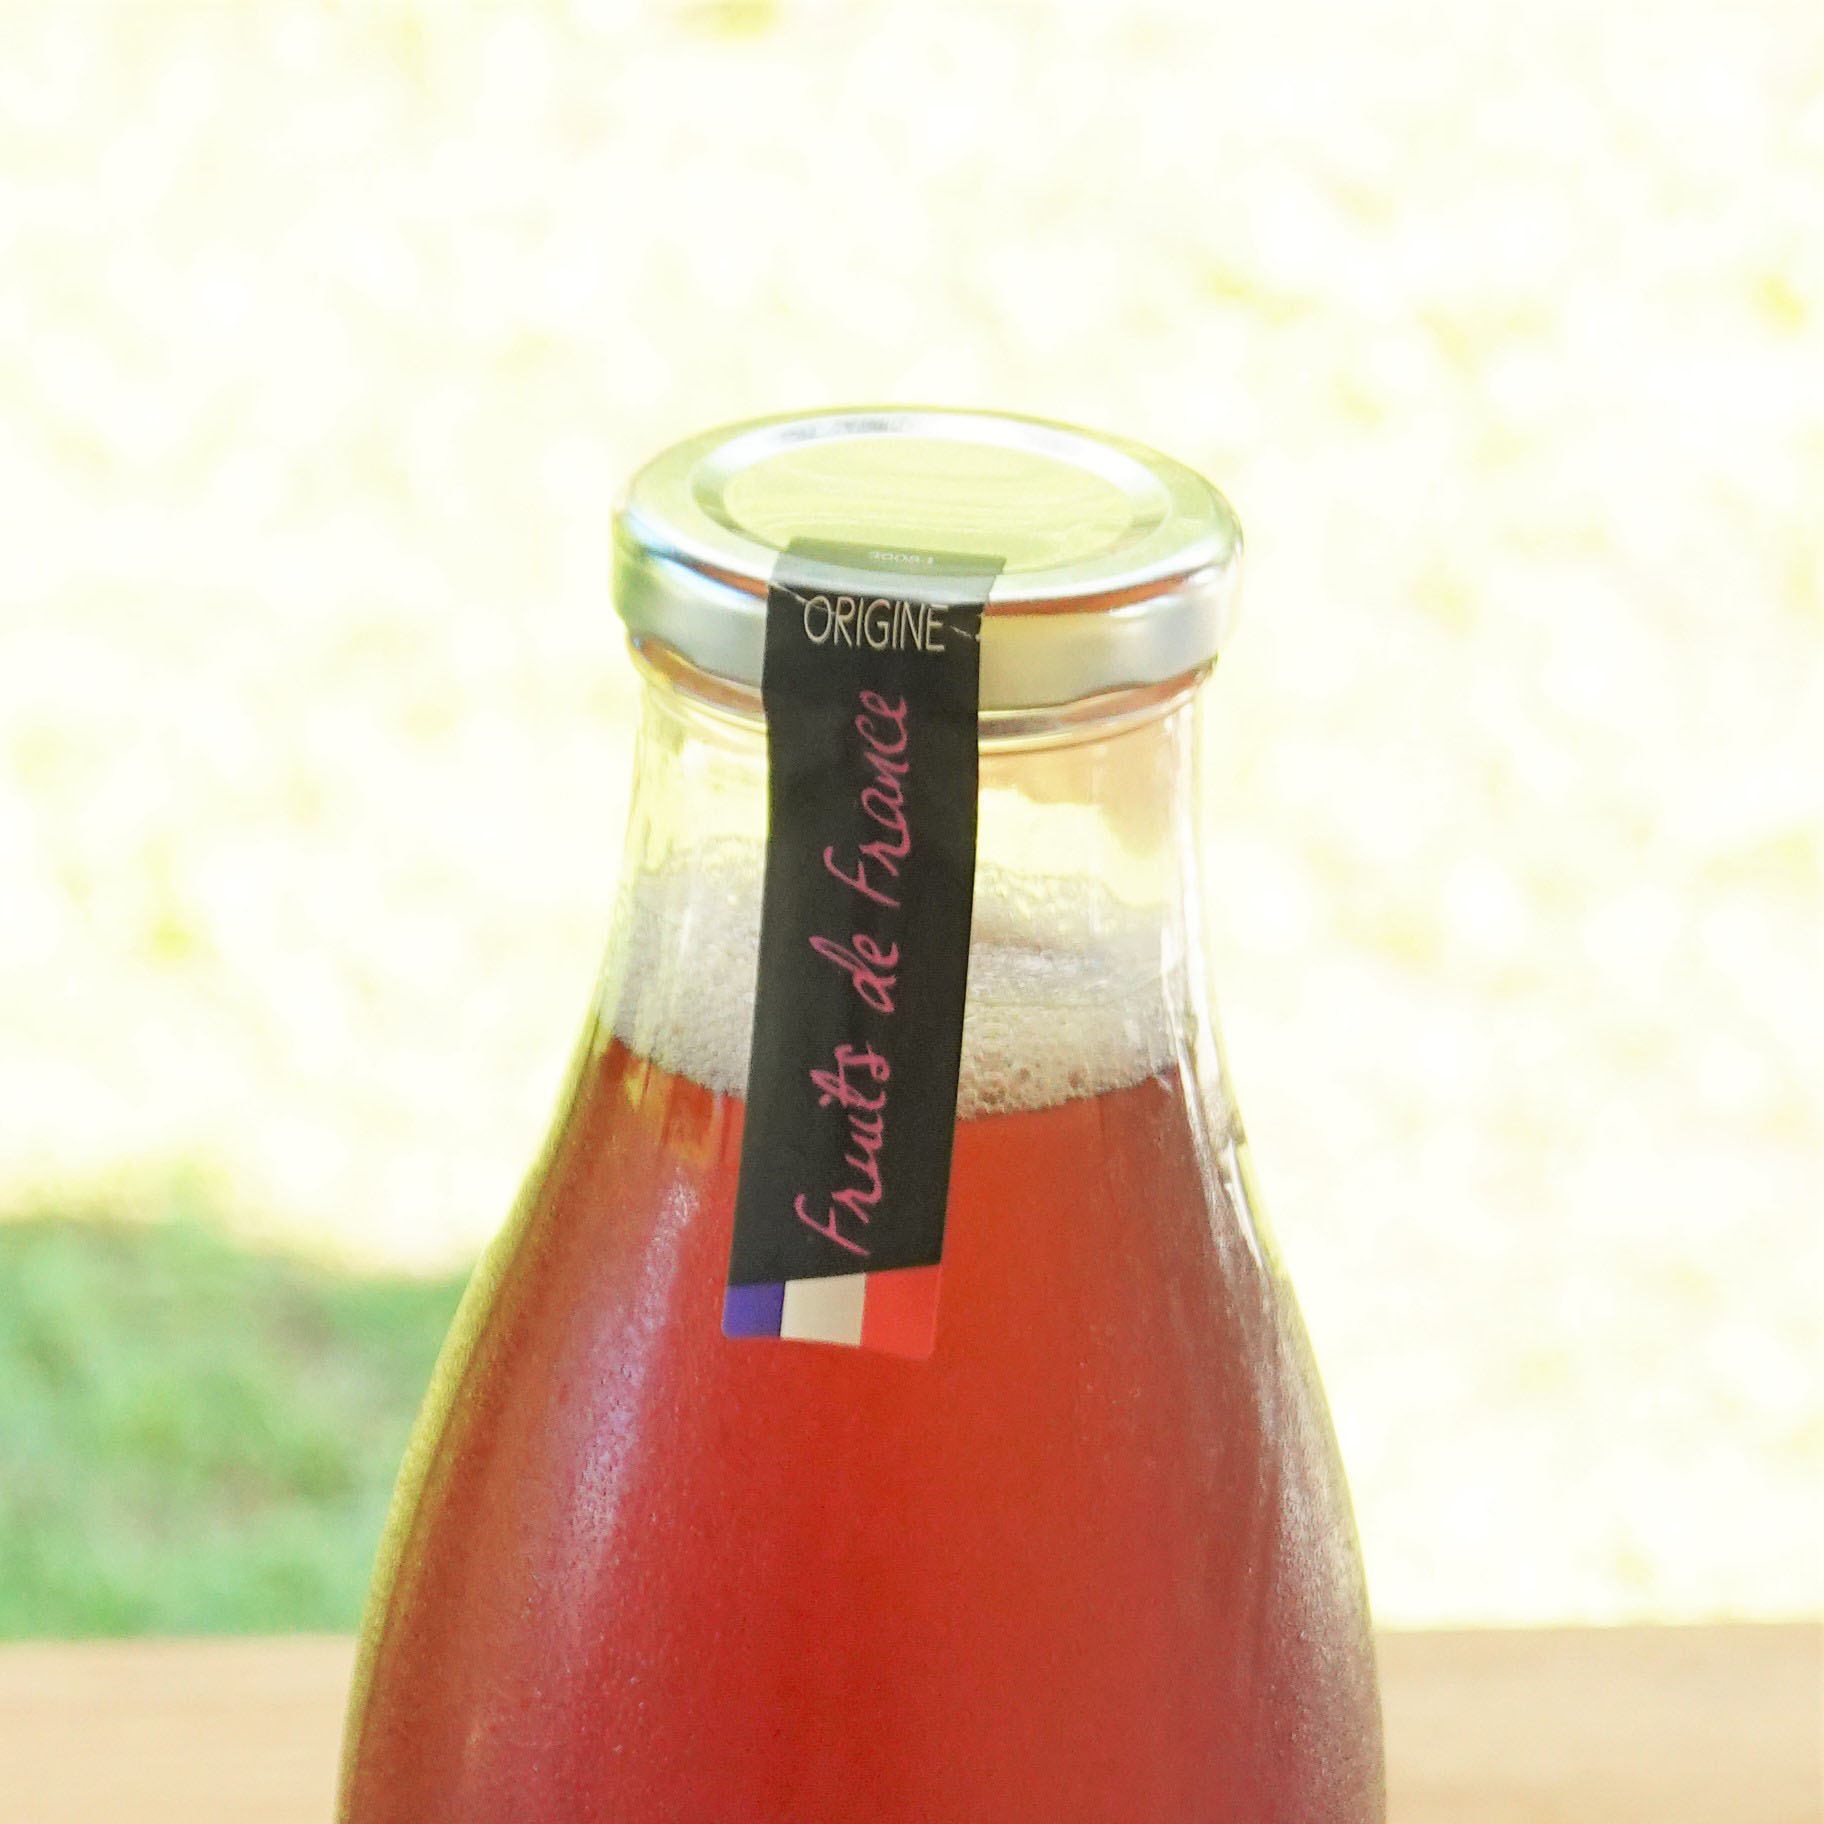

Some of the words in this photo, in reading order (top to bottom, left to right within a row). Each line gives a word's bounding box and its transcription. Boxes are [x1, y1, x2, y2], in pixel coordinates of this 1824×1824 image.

[803, 595, 948, 651] ORIGINE
[823, 689, 911, 909] France
[808, 934, 900, 1014] de
